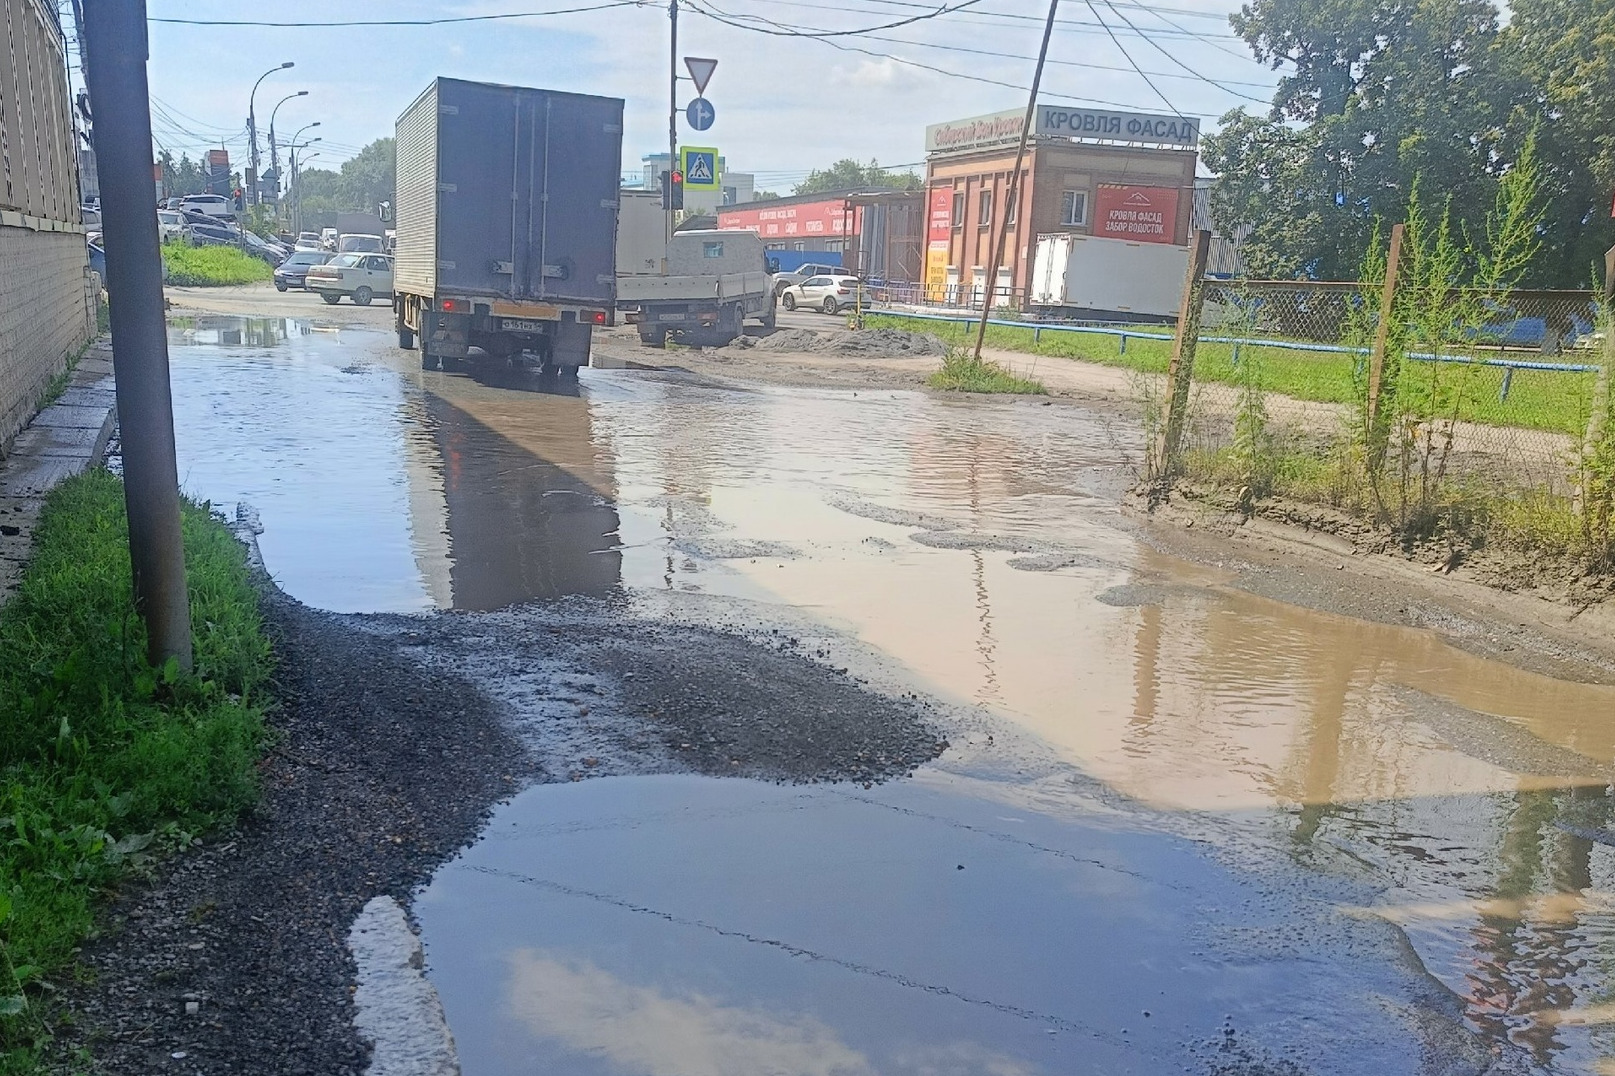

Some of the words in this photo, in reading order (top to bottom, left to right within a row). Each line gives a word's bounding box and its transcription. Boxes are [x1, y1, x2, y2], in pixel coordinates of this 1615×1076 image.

[1044, 110, 1121, 133] КРОВЛЯ
[1125, 117, 1193, 142] ФАСАД
[1109, 210, 1136, 221] КРОВЛЯ
[1137, 211, 1163, 224] ФАСАД
[1105, 221, 1128, 232] ЗАБОР
[1128, 222, 1164, 235] ВОДОСТОК
